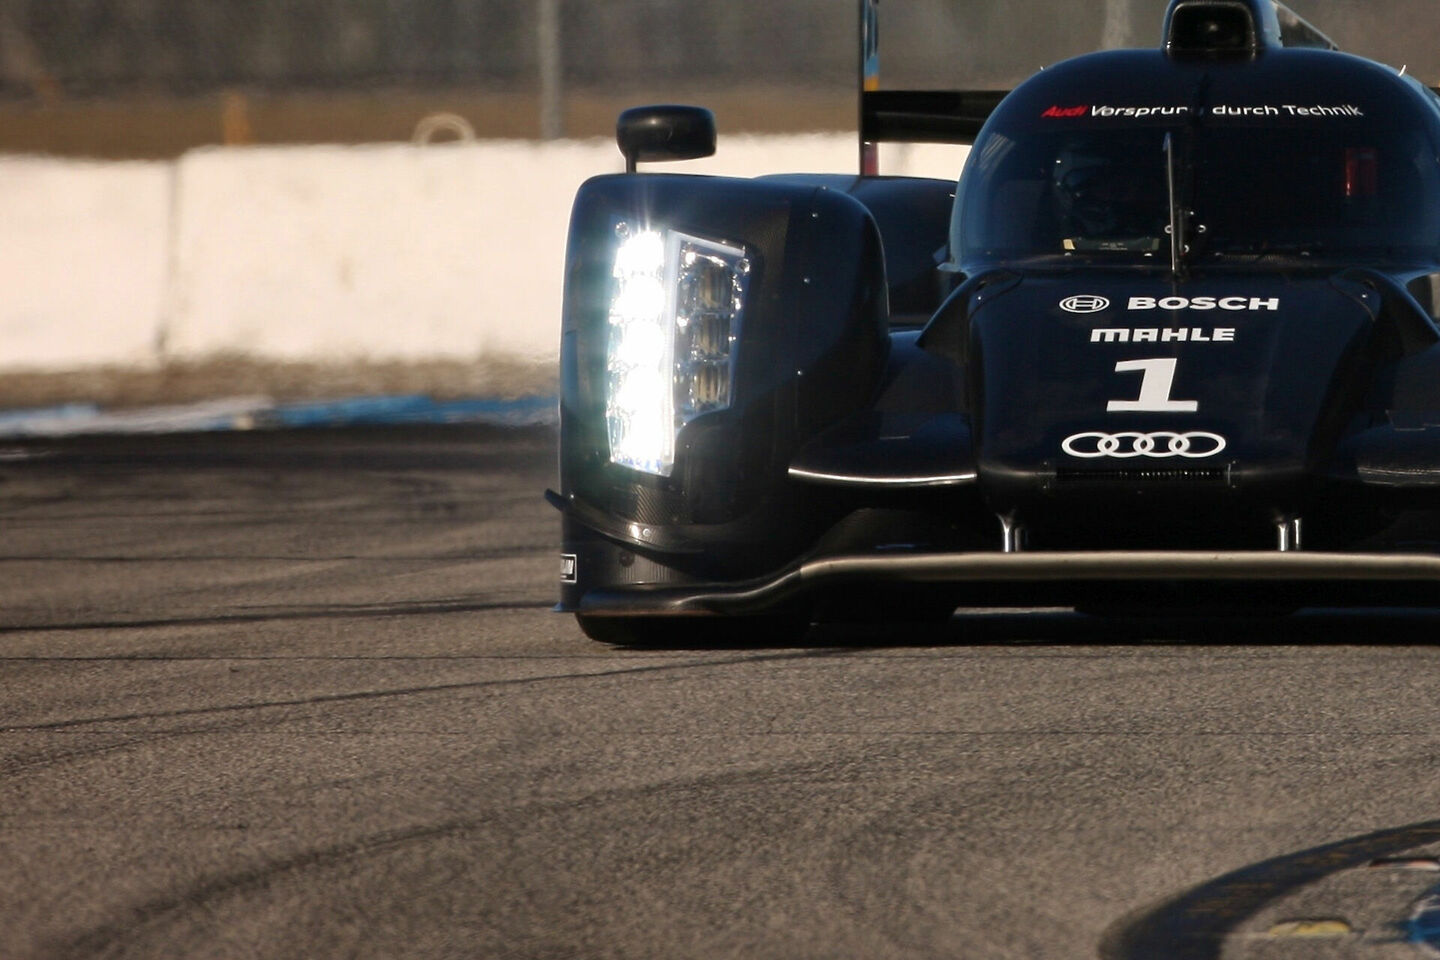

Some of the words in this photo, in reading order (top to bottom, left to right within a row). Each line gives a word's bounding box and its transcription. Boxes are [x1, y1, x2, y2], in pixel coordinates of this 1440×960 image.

[1091, 105, 1190, 117] Vorsprun
[1212, 105, 1279, 115] durch
[1282, 105, 1364, 116] Technik
[1127, 296, 1280, 310] BOSCH
[1090, 328, 1236, 342] MAHLE
[1106, 358, 1198, 412] 1
